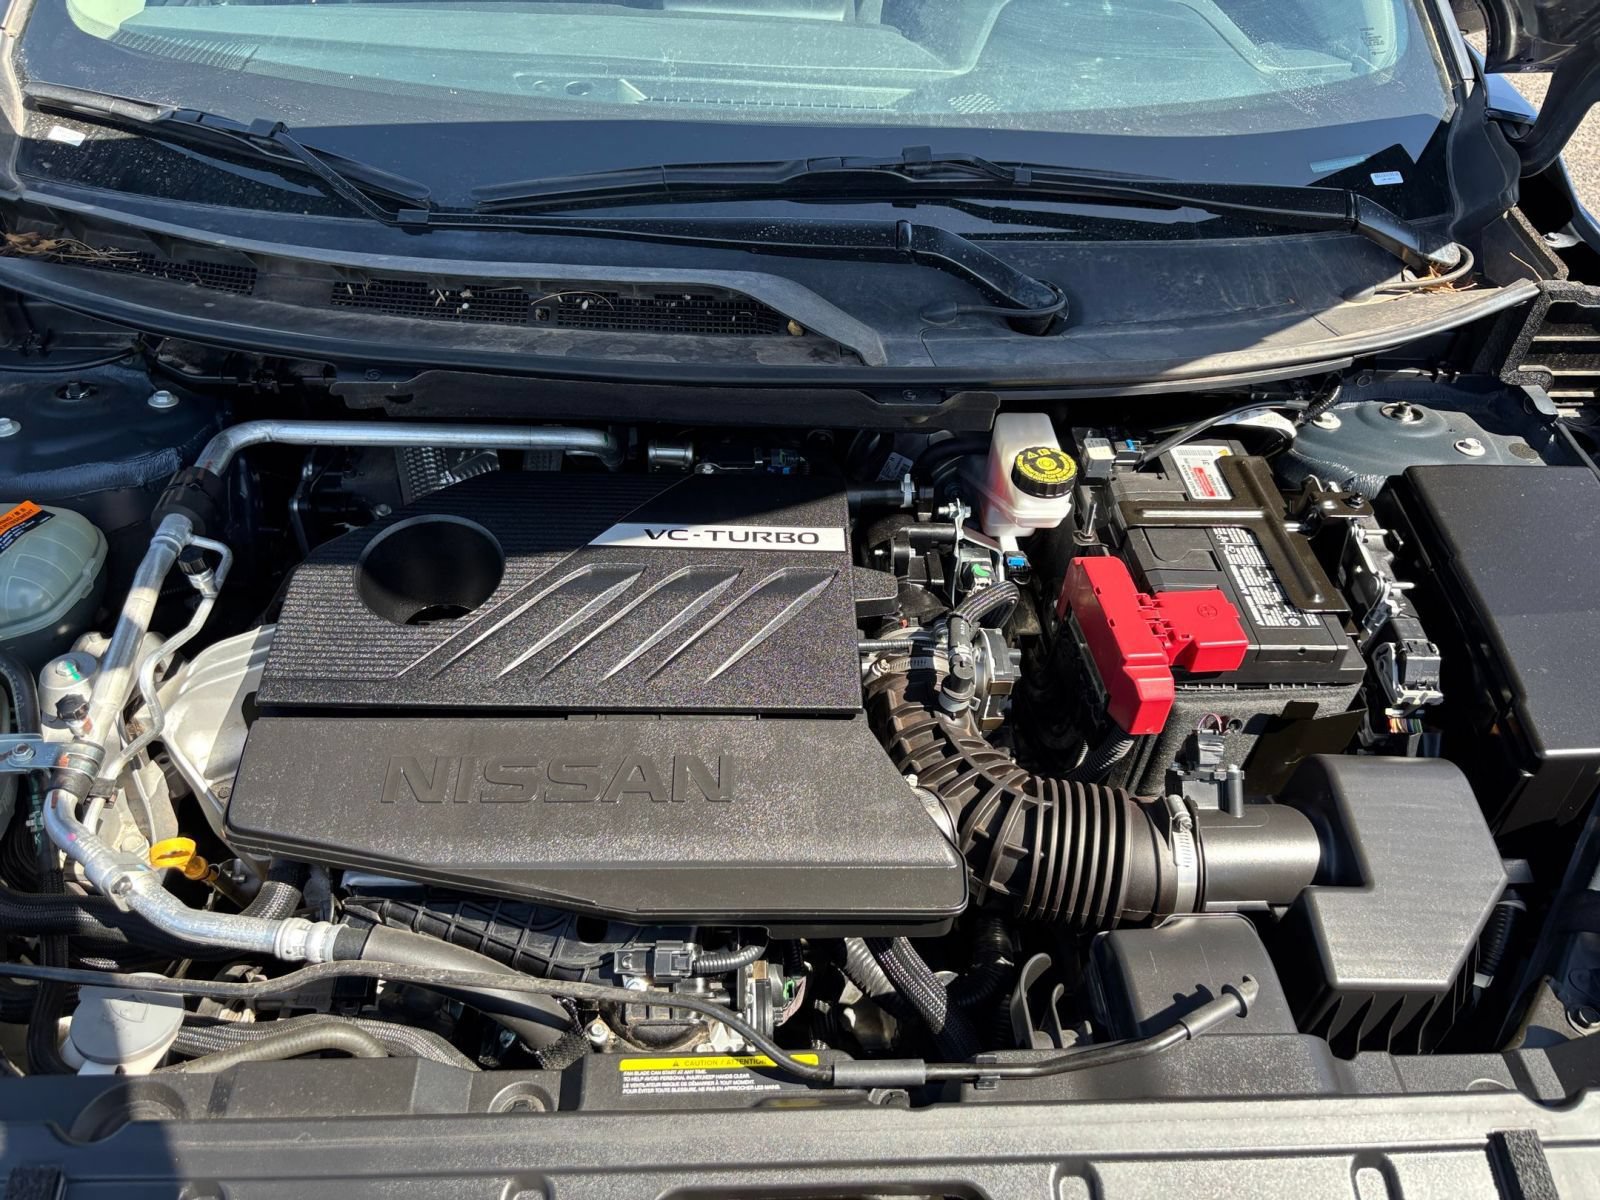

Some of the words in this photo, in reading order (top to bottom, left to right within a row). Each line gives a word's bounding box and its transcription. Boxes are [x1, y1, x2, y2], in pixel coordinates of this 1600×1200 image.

[644, 529, 819, 545] VC-TURBO
[380, 755, 734, 803] NISSAN
[684, 1059, 718, 1067] CAUTION
